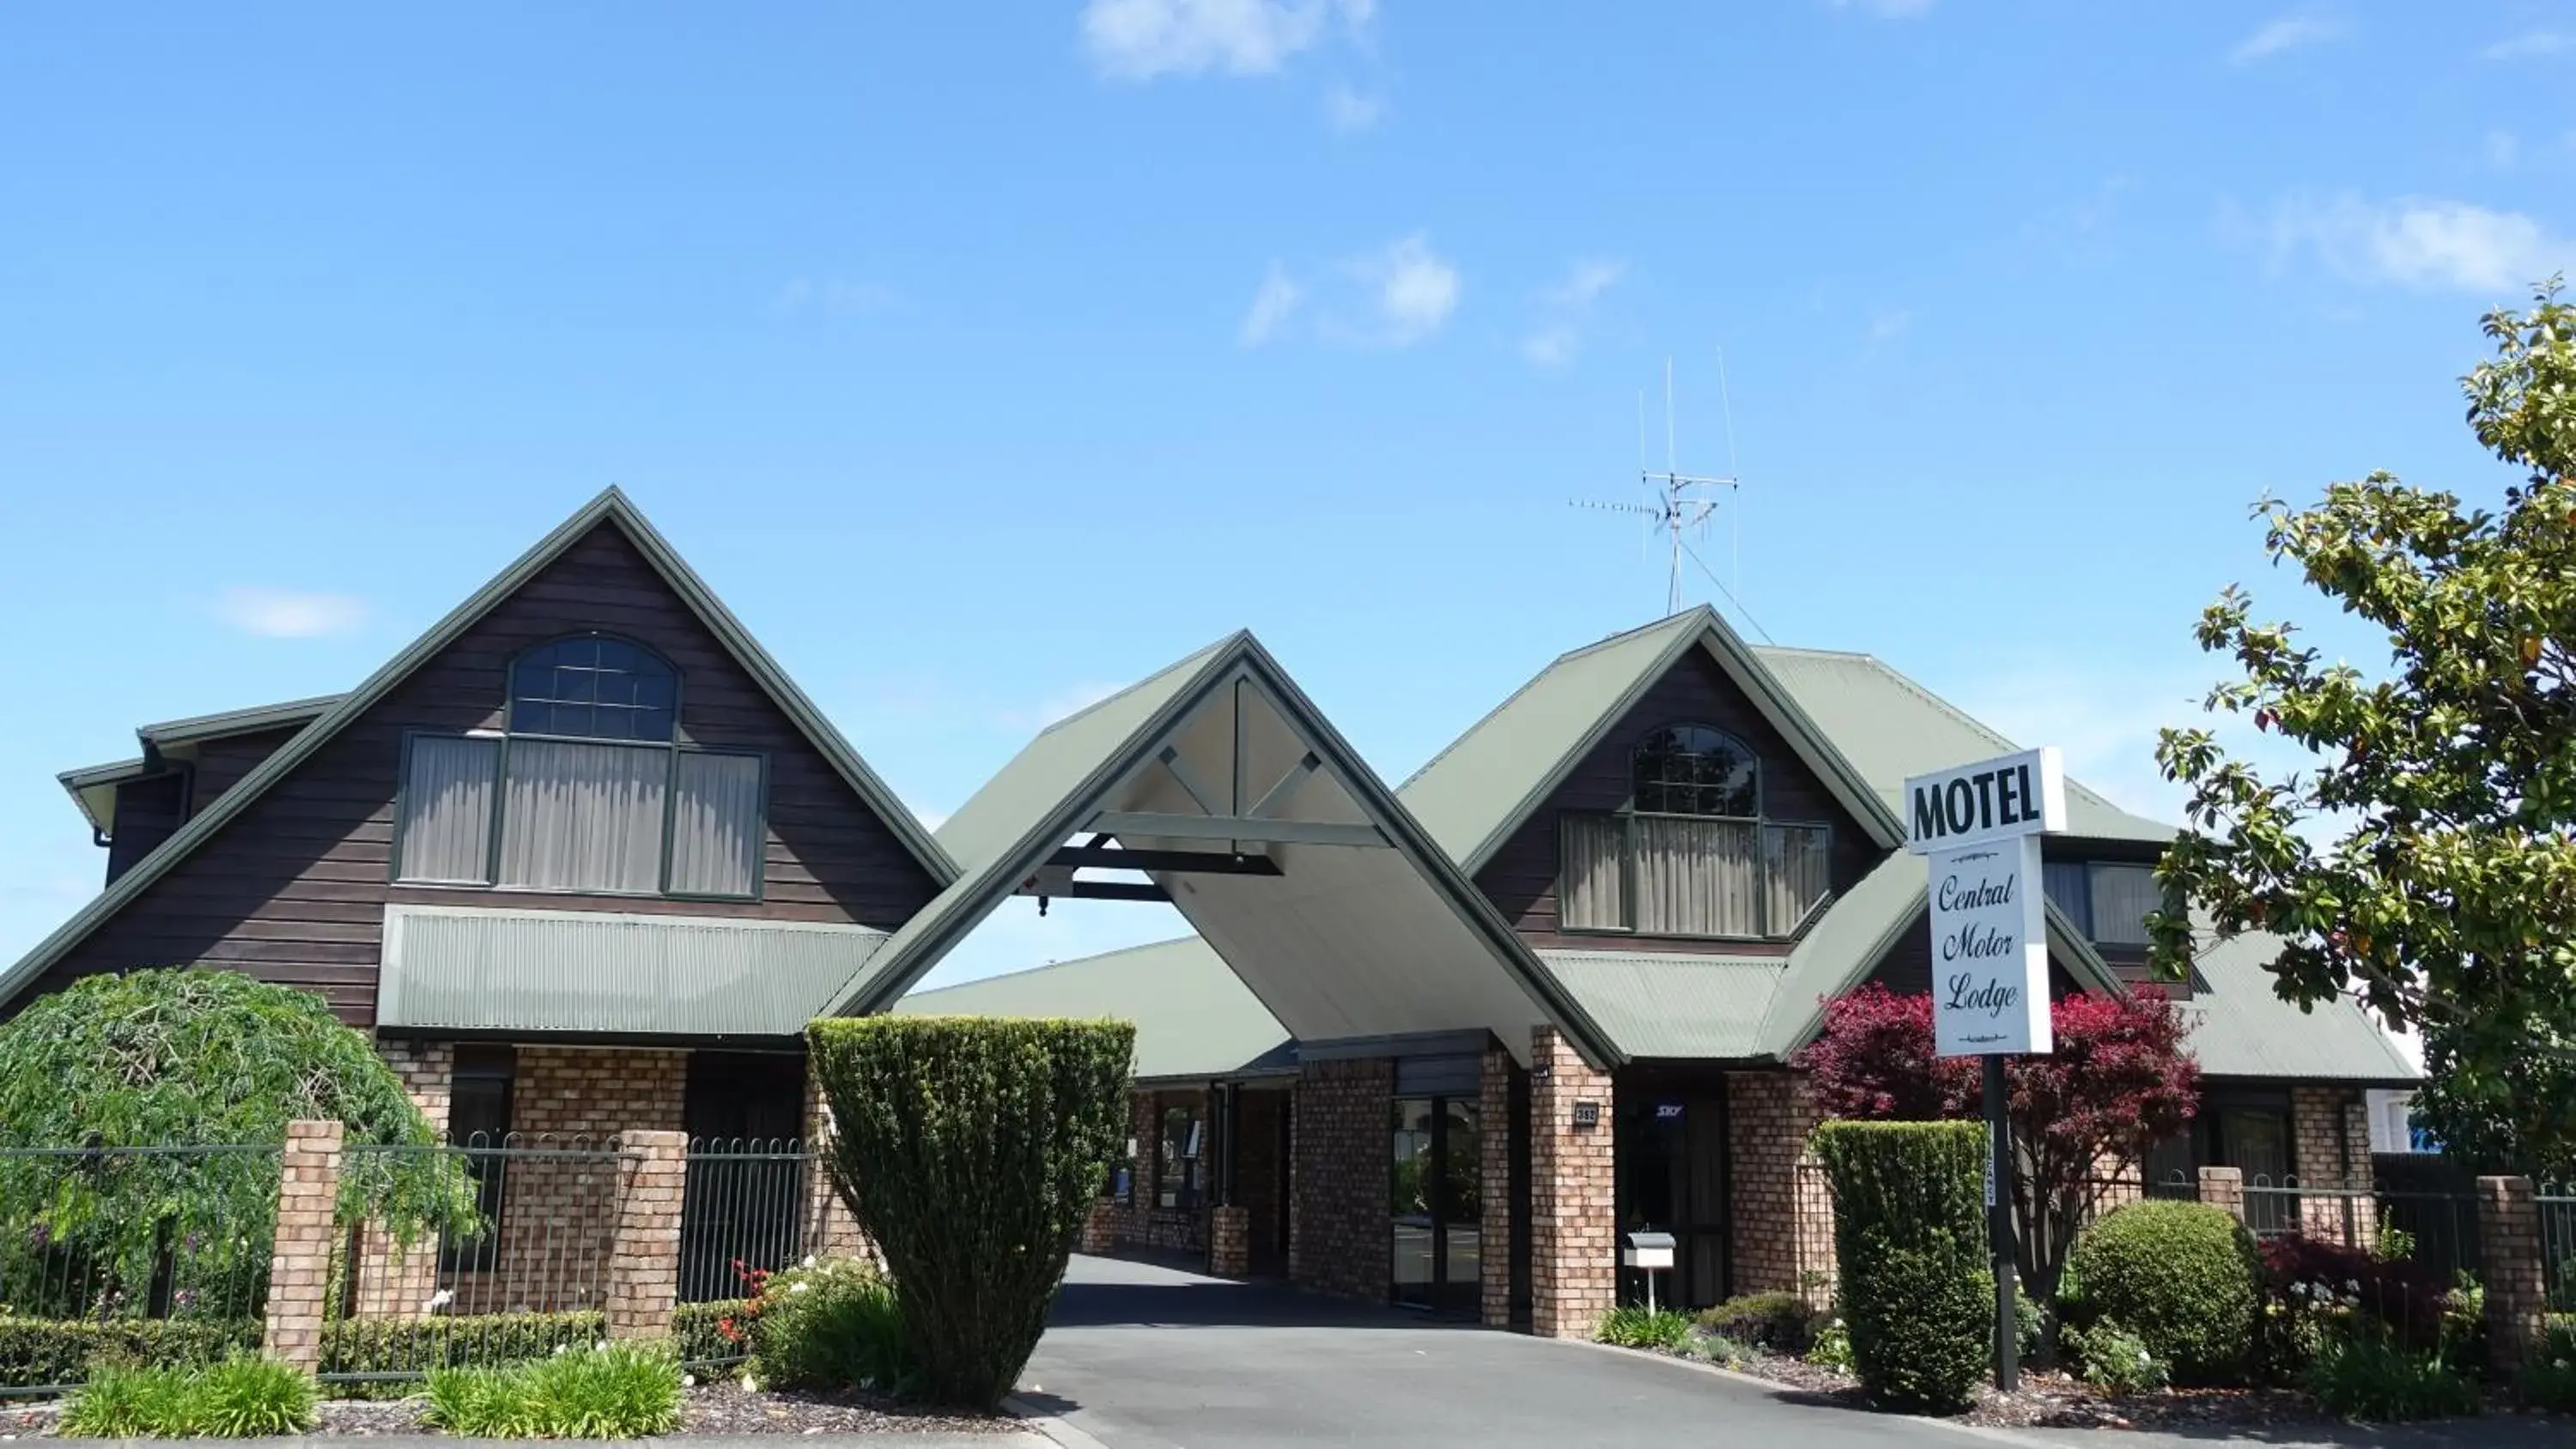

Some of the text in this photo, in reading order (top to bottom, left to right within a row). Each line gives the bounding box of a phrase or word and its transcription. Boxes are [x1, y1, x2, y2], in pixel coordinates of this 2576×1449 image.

[1914, 764, 2040, 841] MOTEL
[1938, 873, 2014, 912] Central
[1943, 921, 2014, 961] Motor
[1944, 972, 2019, 1019] Lodge
[1656, 1105, 1683, 1117] SKY
